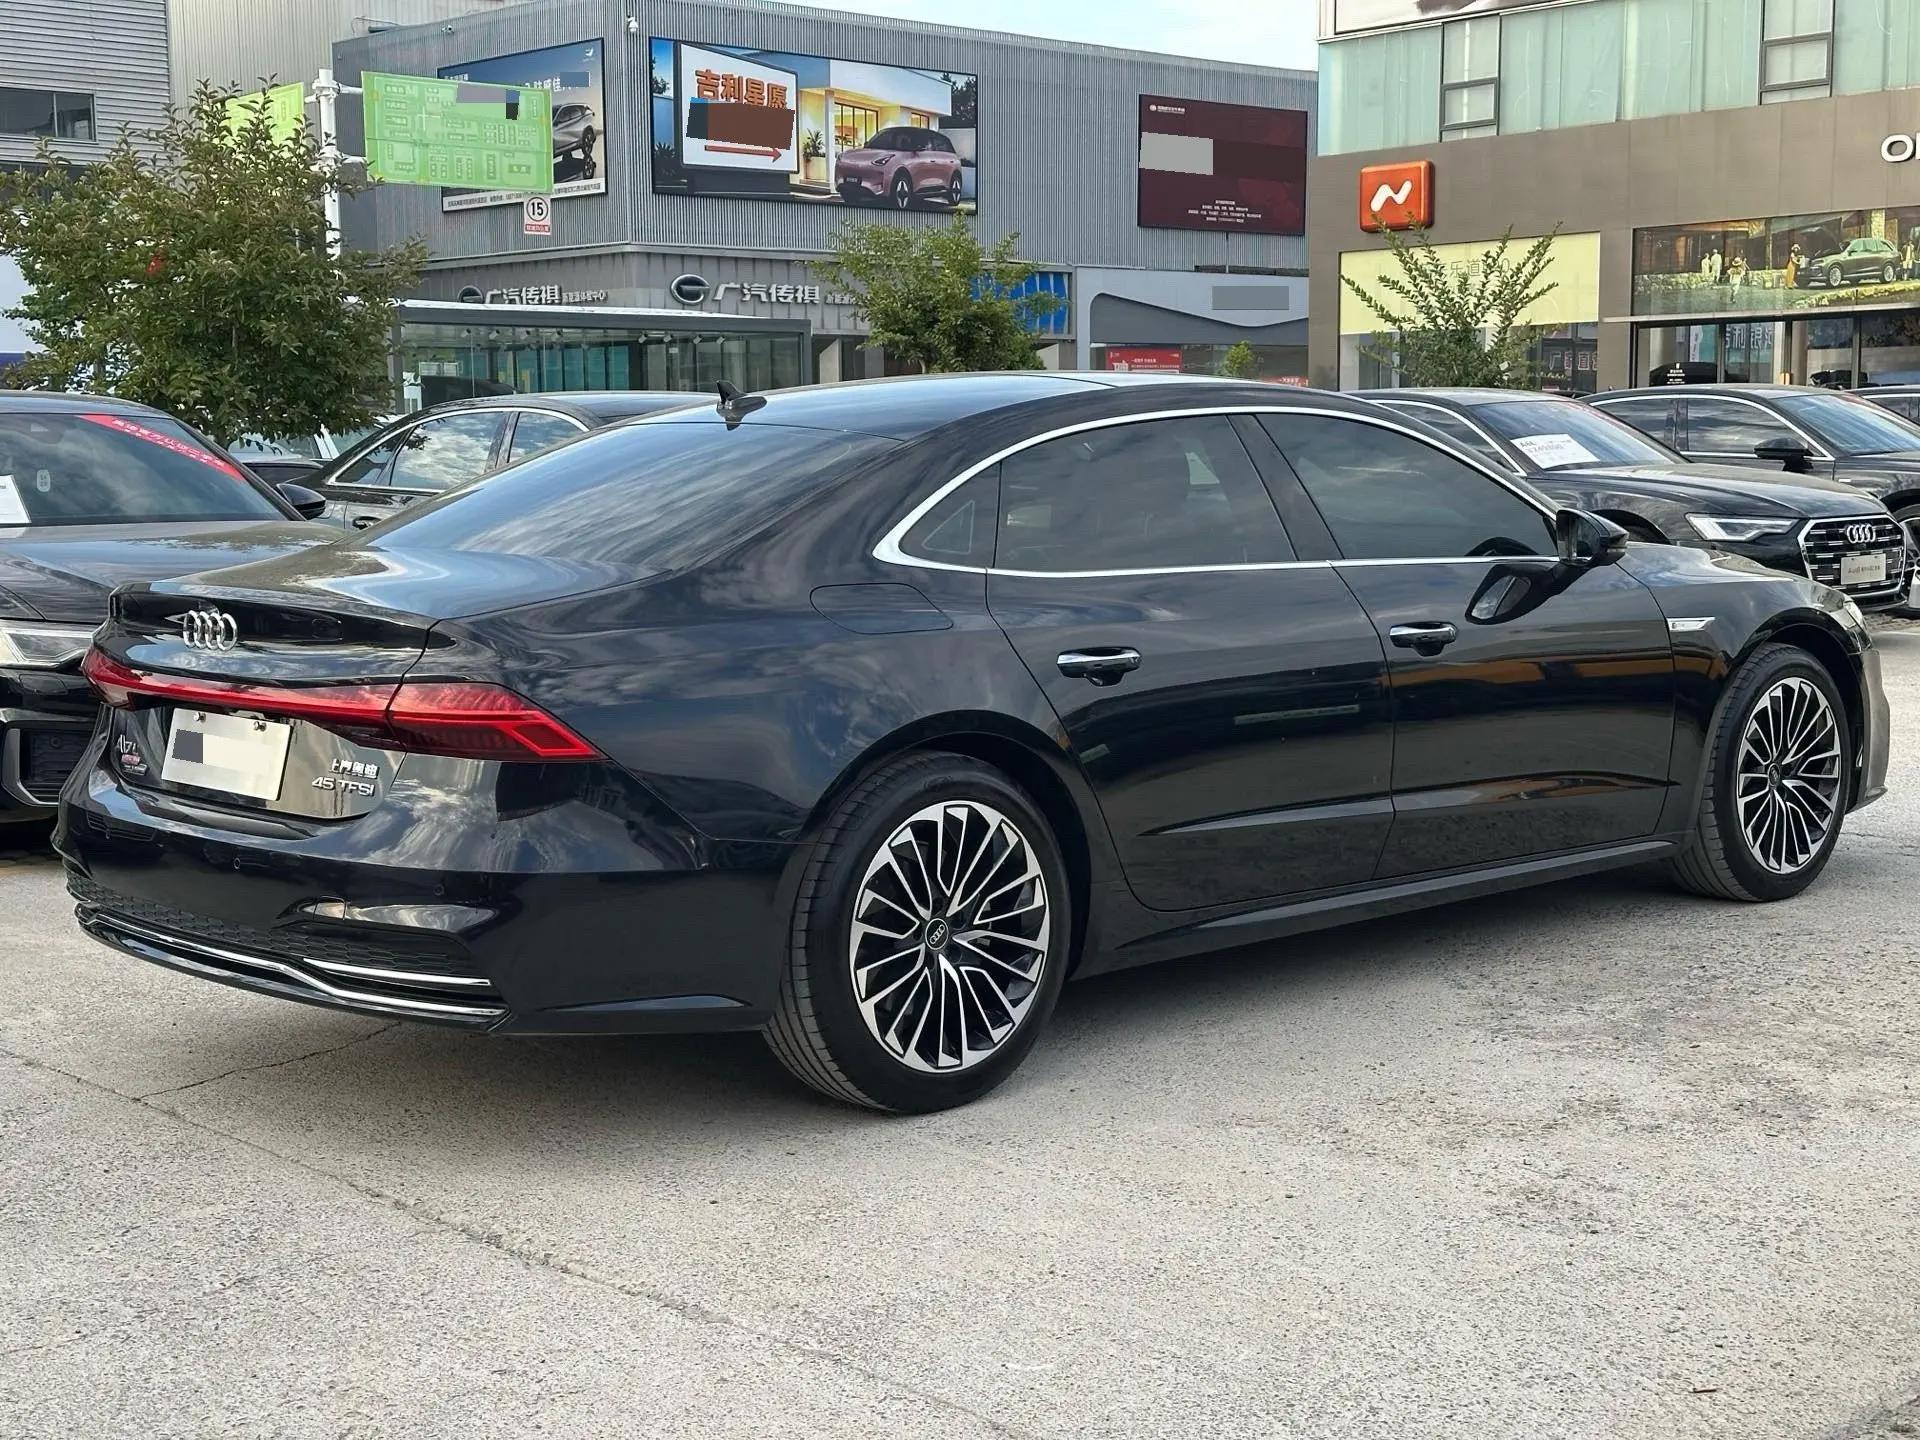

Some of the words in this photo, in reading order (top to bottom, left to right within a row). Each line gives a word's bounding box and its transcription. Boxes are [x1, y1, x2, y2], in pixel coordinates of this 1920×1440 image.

[695, 69, 787, 109] 吉利星愿
[1881, 132, 1920, 162] O
[531, 202, 544, 216] 15
[485, 285, 561, 304] 广汽传祺
[713, 283, 820, 304] 广汽传祺
[331, 758, 378, 778] 上汽奥迪
[311, 777, 335, 790] 45
[338, 780, 375, 796] TFSI
